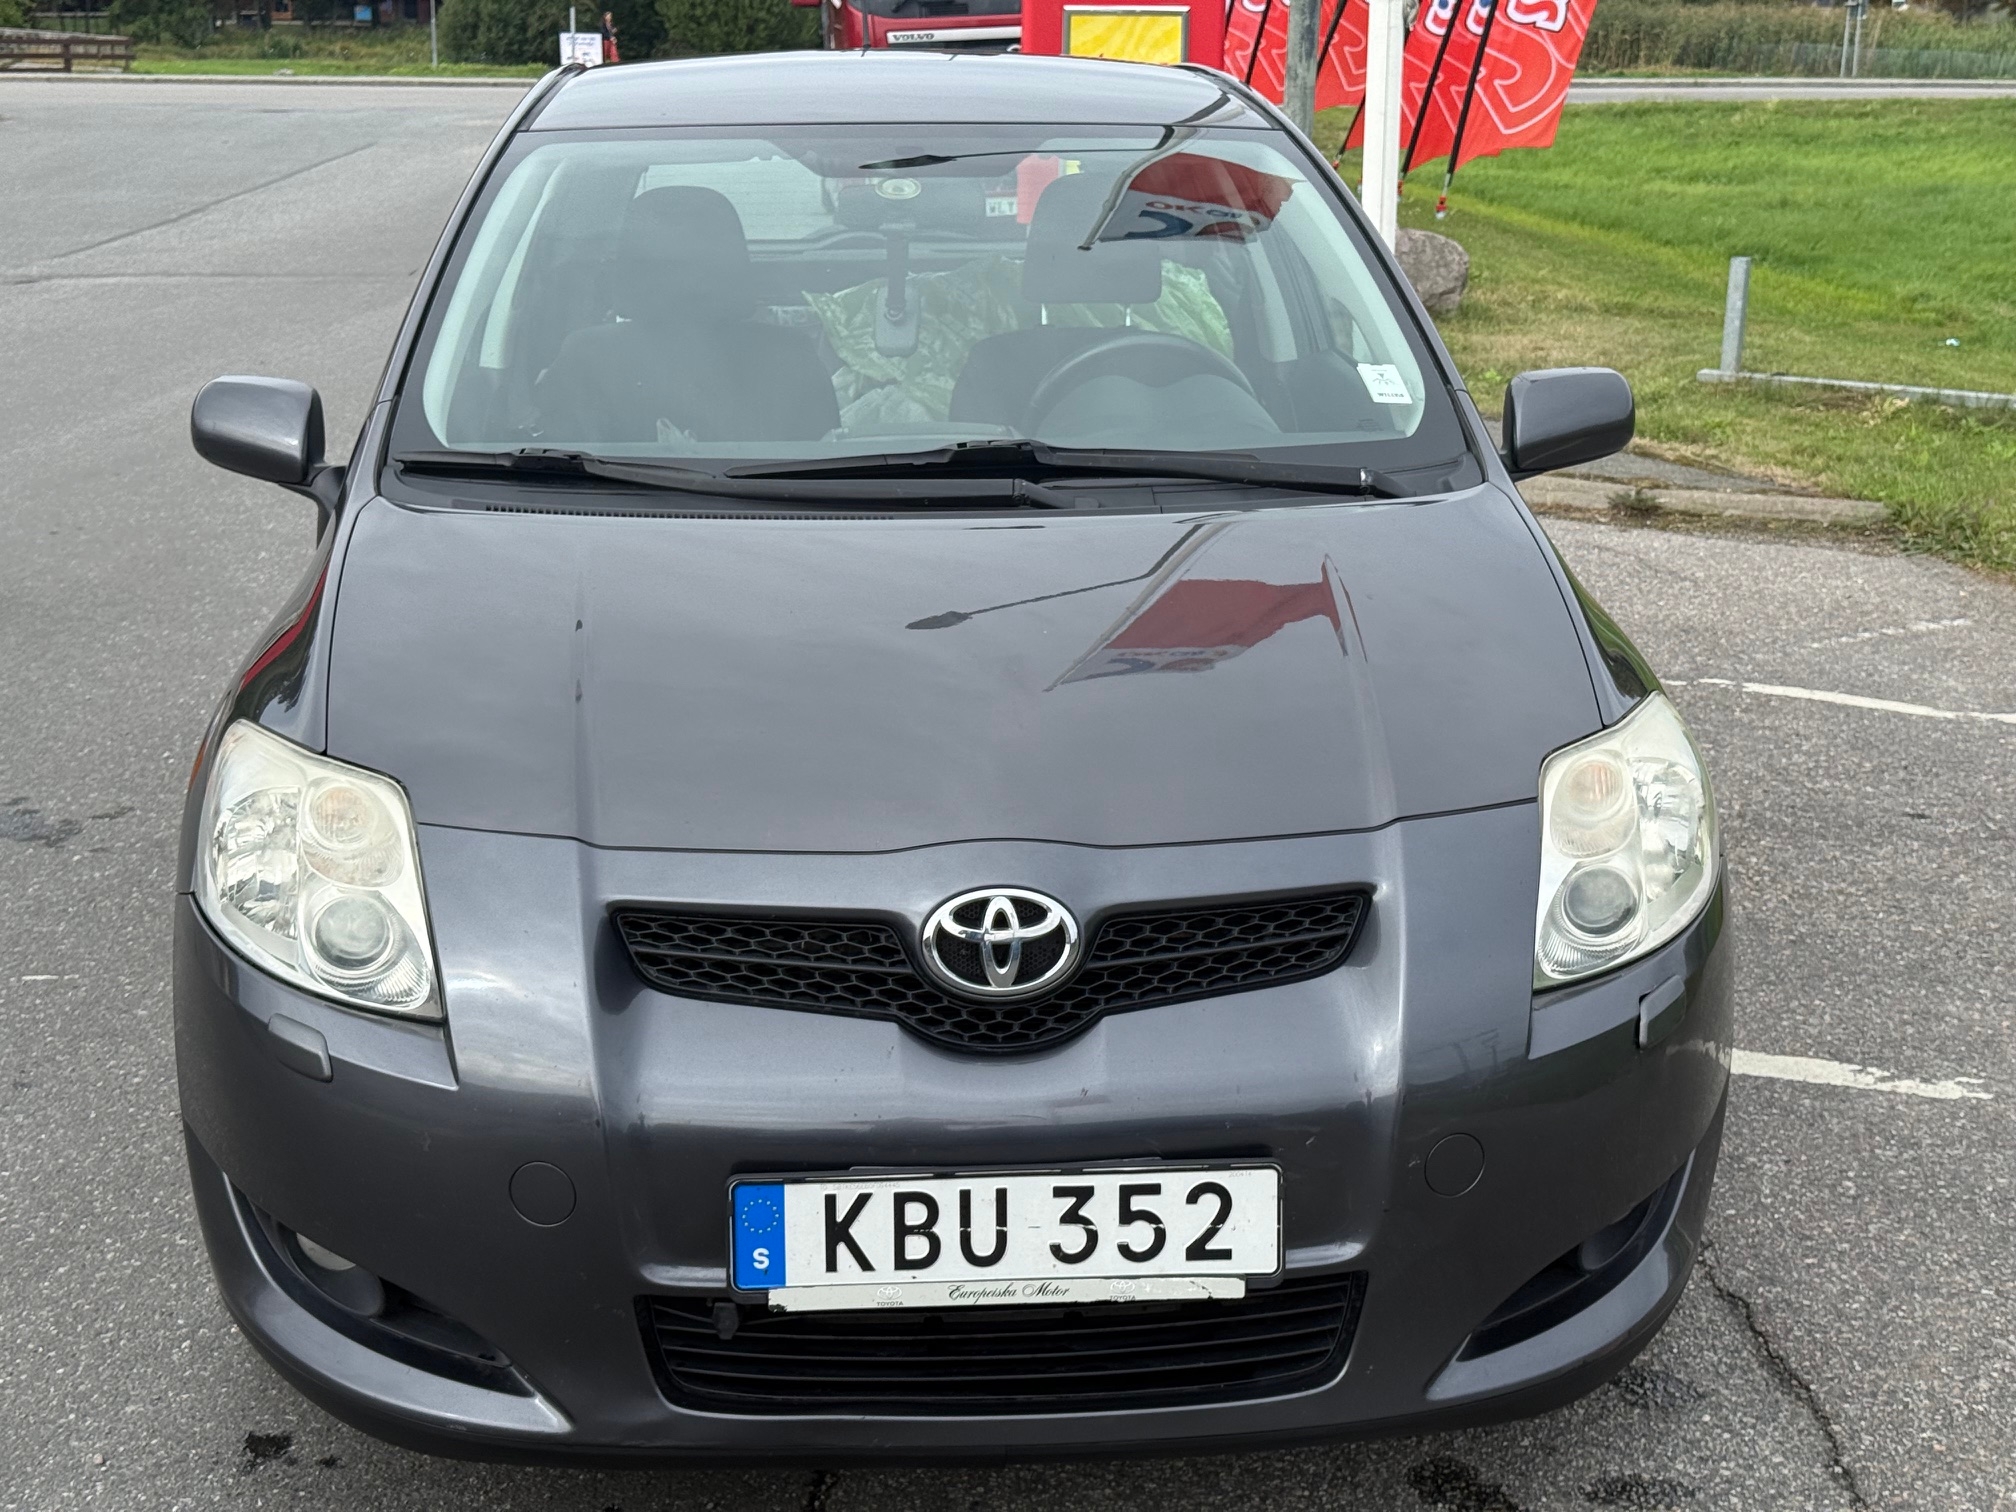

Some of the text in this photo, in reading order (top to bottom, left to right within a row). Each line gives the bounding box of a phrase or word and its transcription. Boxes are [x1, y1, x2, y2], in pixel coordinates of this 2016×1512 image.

[892, 33, 935, 41] VOLVO
[824, 1181, 1233, 1273] KBU 352
[753, 1247, 770, 1270] S
[948, 1281, 1071, 1304] Europeiska Motor
